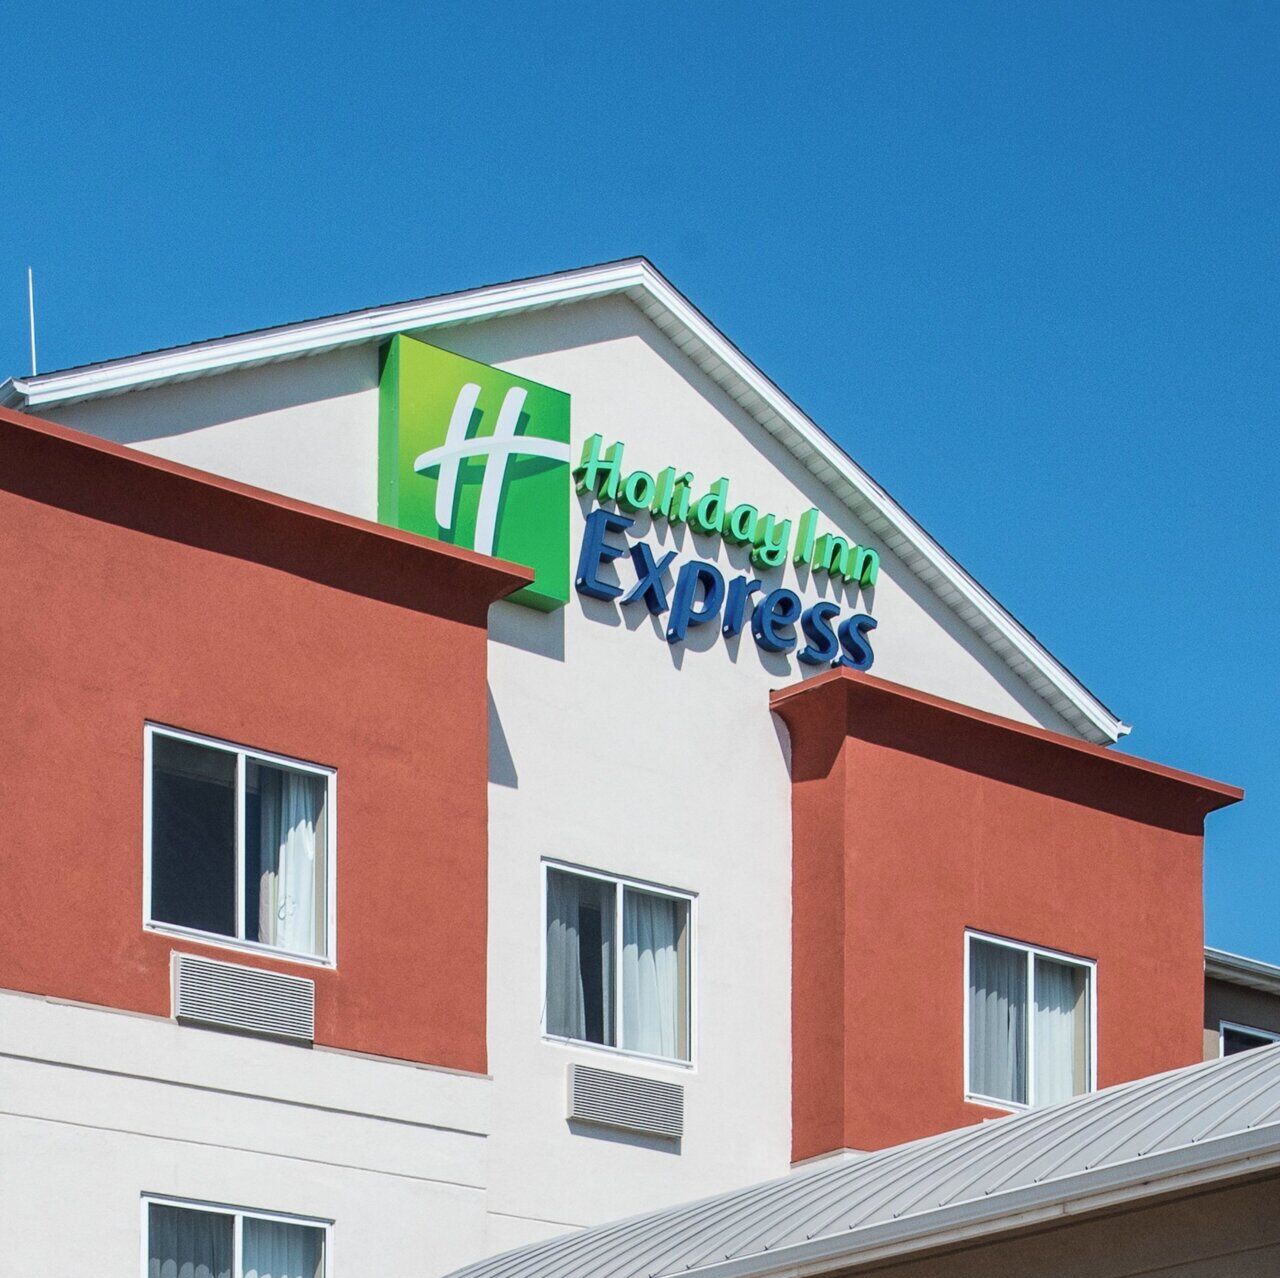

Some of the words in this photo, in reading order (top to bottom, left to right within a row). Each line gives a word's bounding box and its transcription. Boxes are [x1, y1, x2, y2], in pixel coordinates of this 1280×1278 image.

[573, 433, 792, 571] Holiday
[793, 507, 880, 590] Inn
[575, 508, 878, 672] Express
